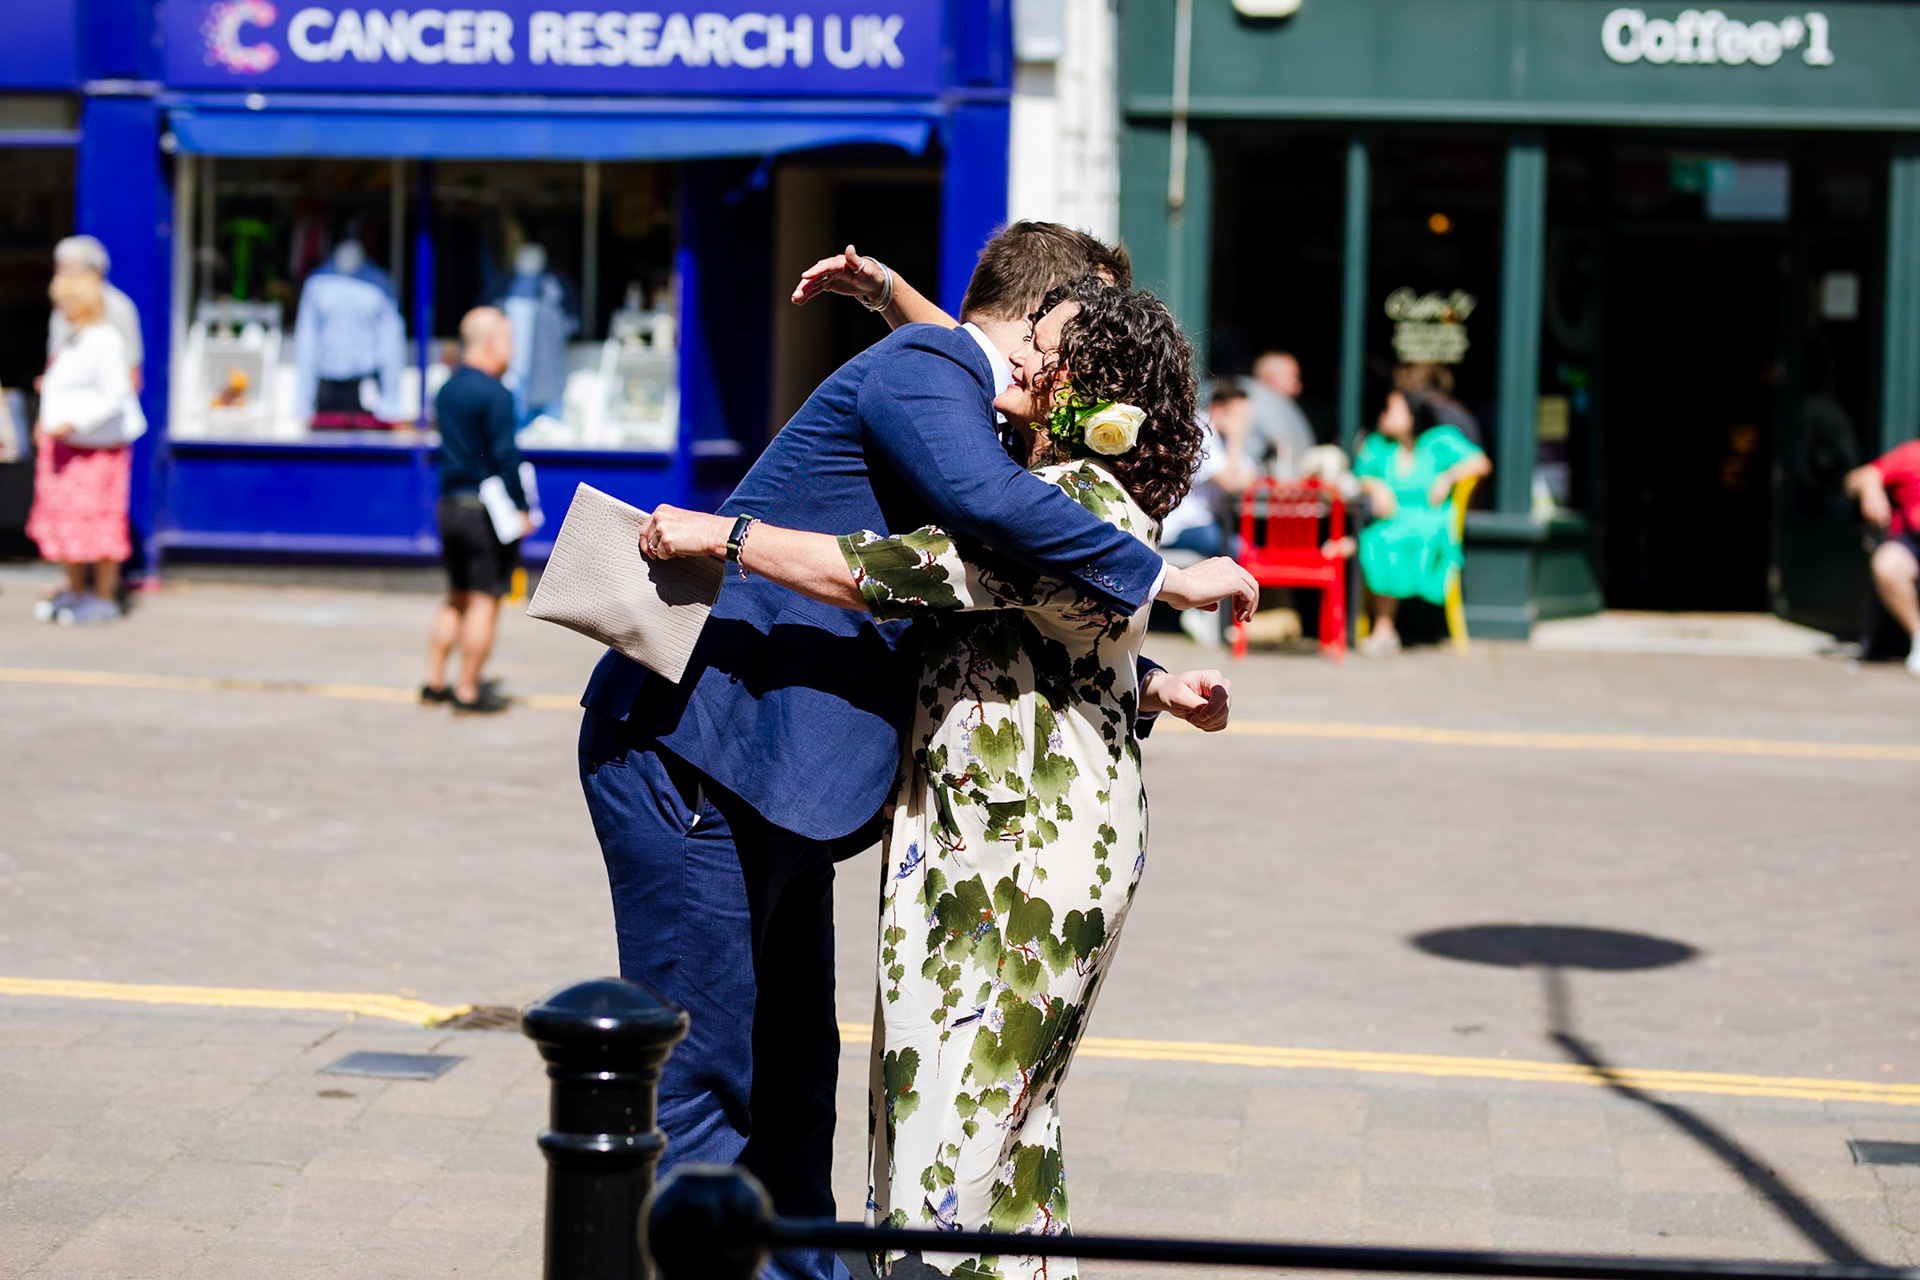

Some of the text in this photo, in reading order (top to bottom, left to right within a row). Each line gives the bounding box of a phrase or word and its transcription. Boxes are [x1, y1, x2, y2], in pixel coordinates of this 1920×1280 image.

[288, 8, 904, 69] CANCER RESEARCH UK
